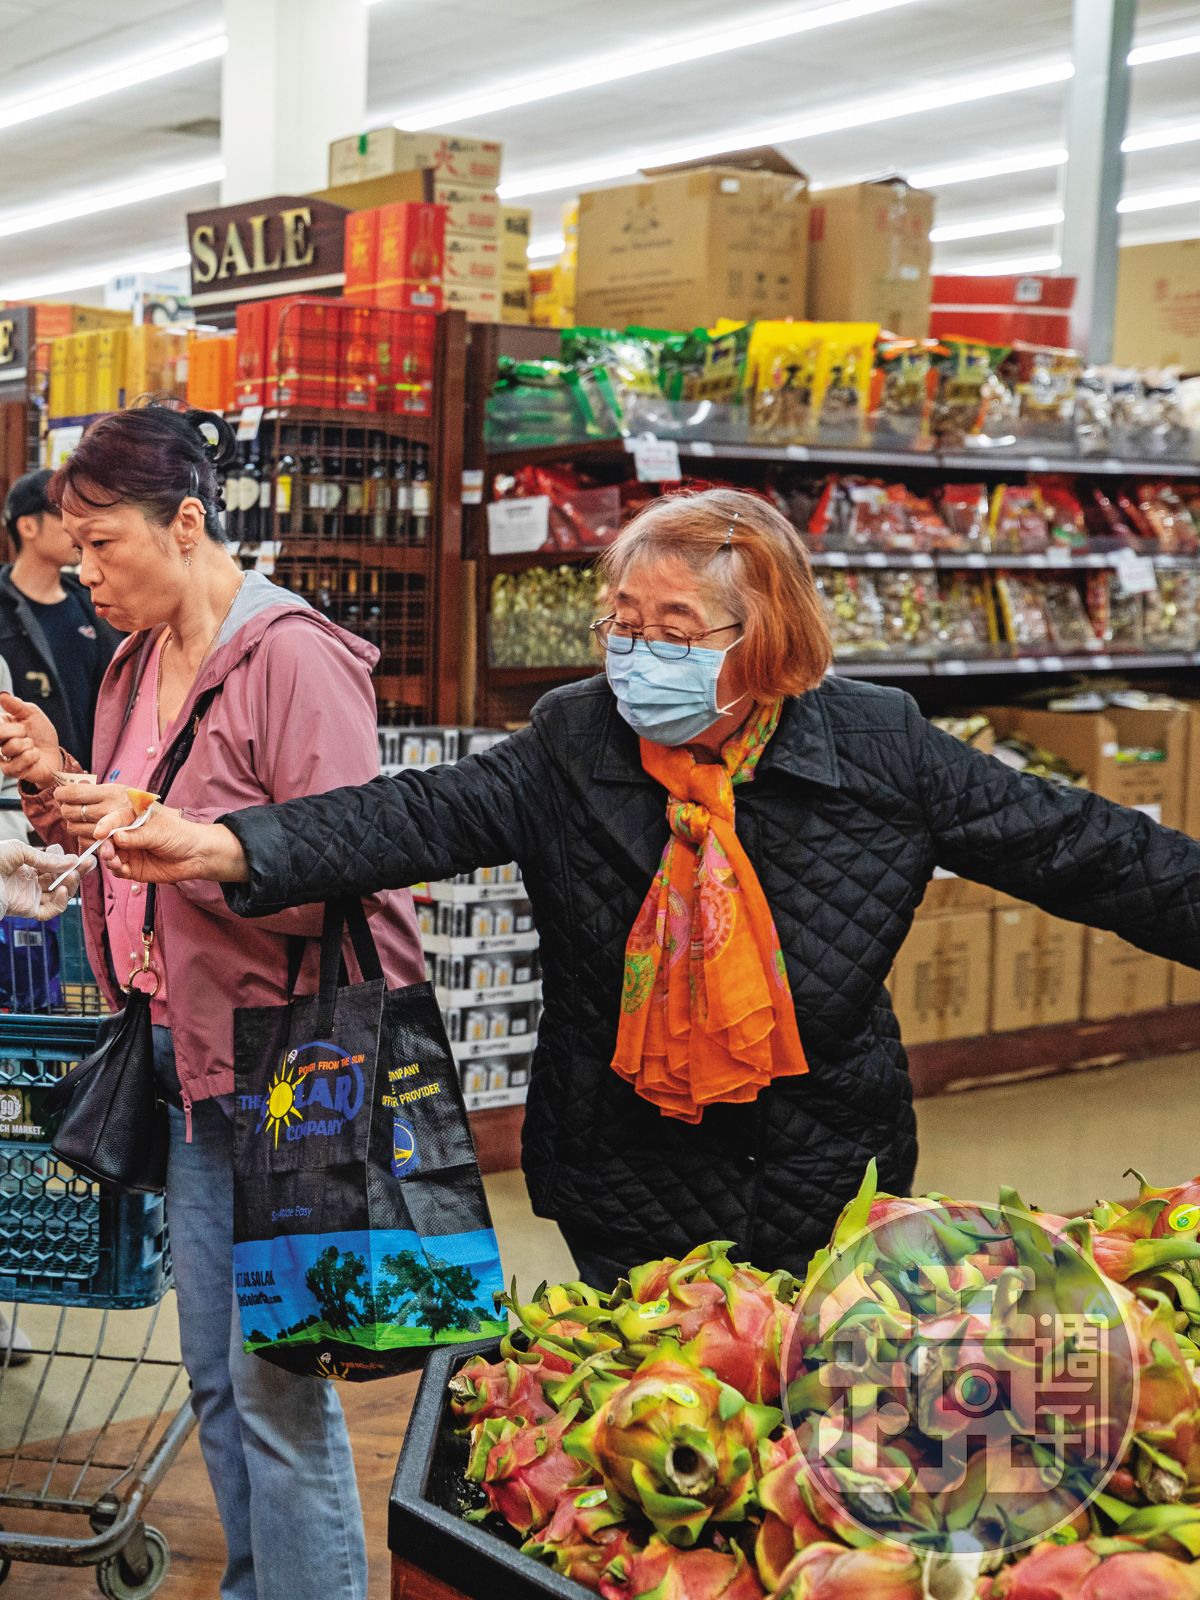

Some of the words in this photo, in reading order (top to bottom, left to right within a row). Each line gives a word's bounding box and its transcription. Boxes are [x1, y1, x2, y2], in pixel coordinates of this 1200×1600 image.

[191, 206, 315, 284] SALE
[318, 1059, 339, 1071] FROM
[351, 1054, 365, 1065] SUN
[399, 1082, 441, 1105] PROVIDER
[0, 1099, 15, 1116] 99
[286, 1117, 347, 1141] COMPANY
